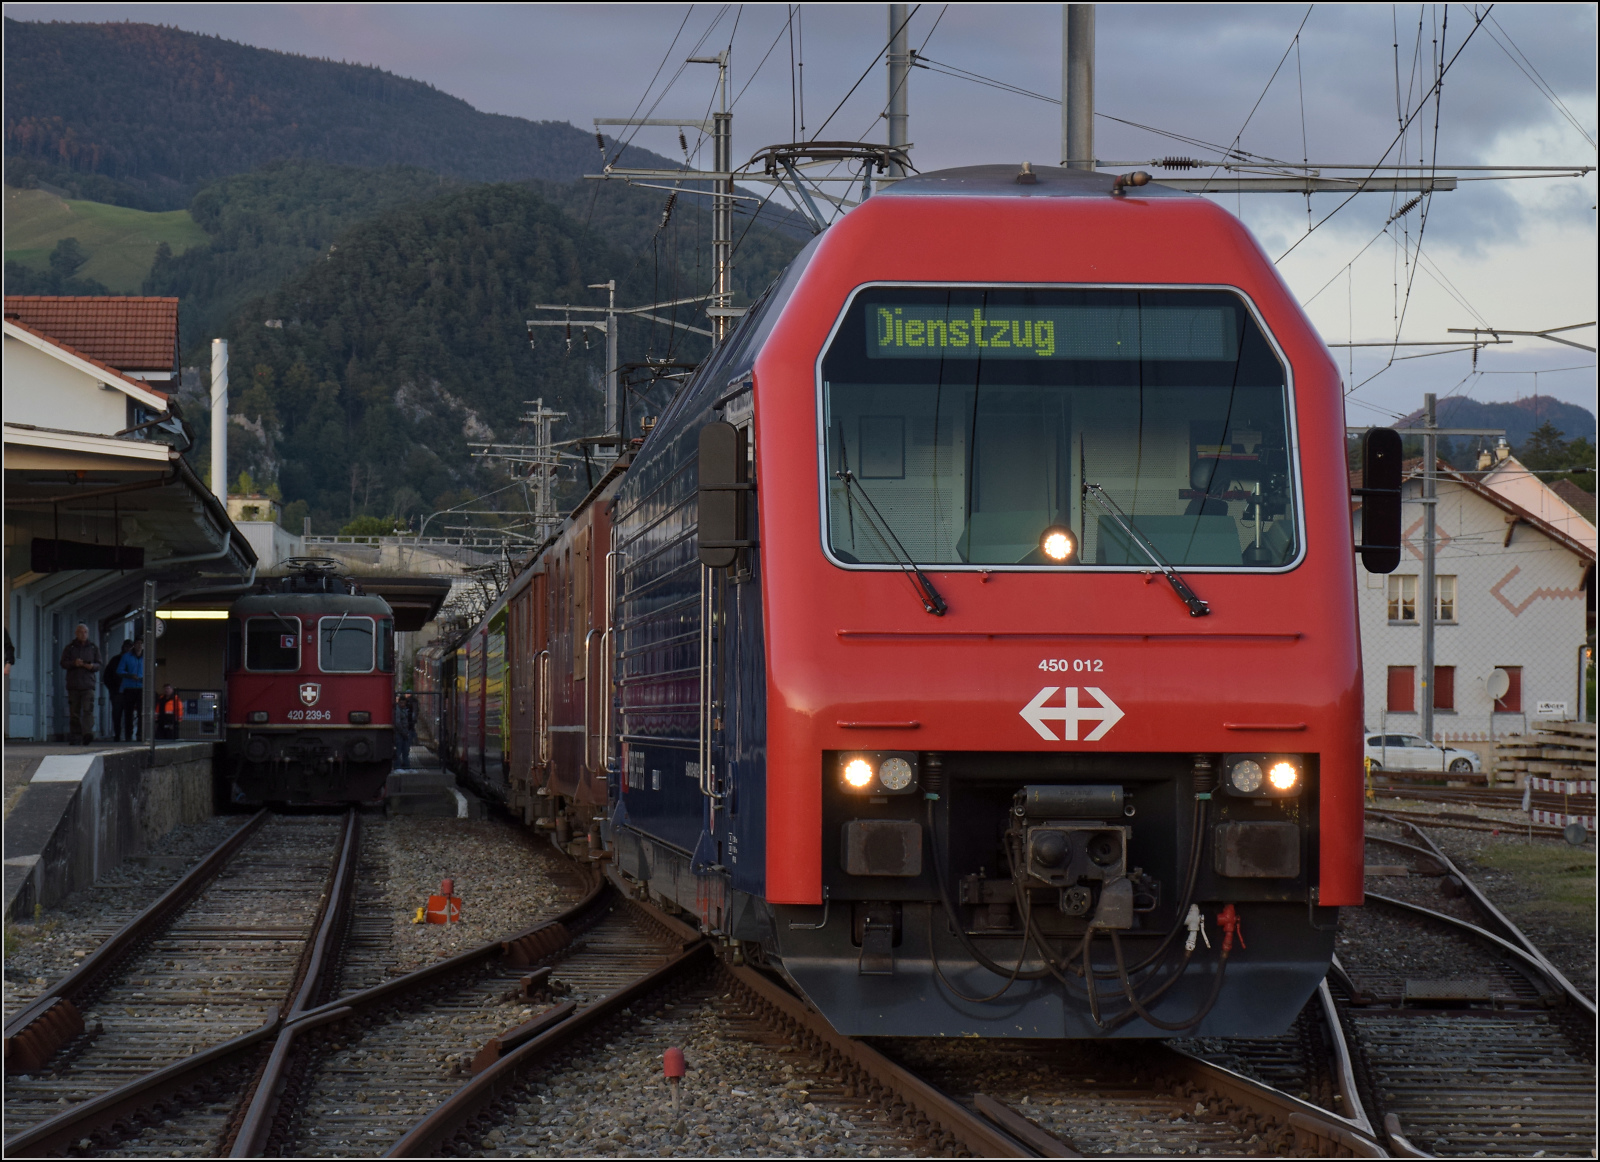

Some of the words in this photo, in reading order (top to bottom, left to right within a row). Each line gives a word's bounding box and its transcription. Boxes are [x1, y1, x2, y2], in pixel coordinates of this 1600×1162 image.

[877, 307, 1055, 356] Dienstzug
[1038, 659, 1068, 672] 450
[1073, 659, 1104, 672] 012
[287, 710, 303, 720] 420
[305, 710, 331, 720] 239-6
